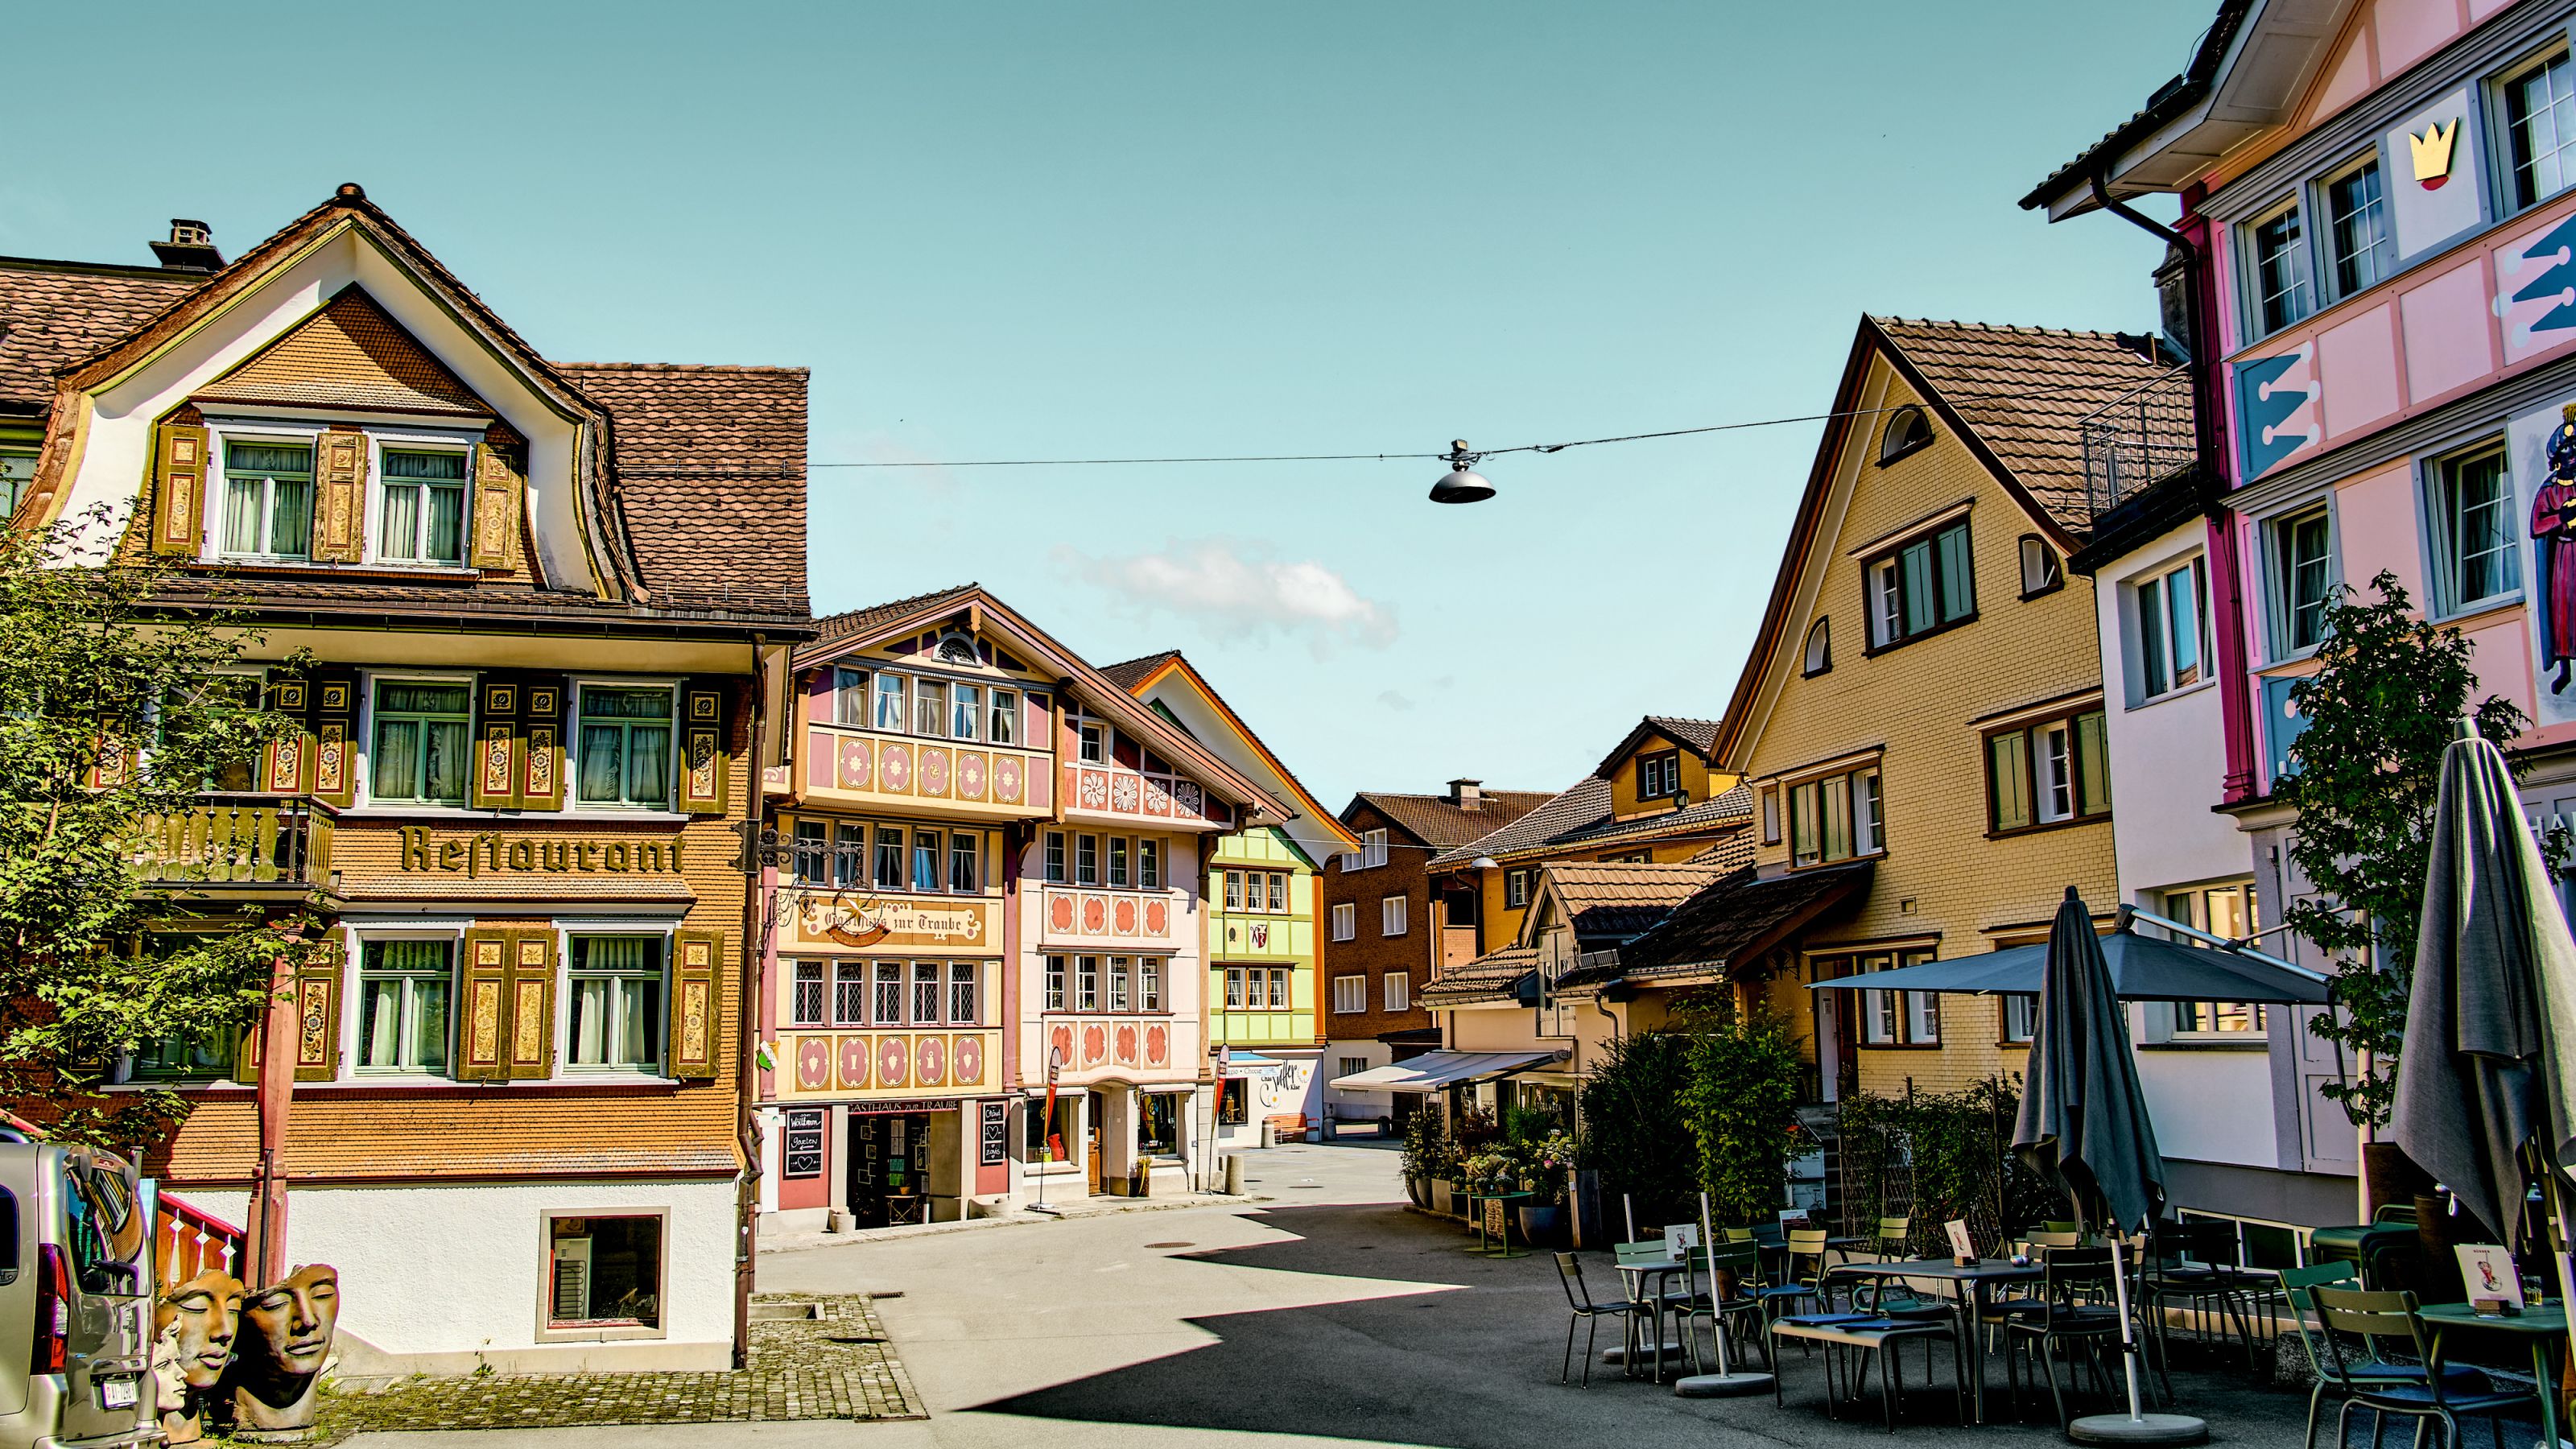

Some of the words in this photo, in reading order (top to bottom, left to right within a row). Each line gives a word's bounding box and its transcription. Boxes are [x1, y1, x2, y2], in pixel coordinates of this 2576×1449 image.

[2529, 811, 2576, 840] HA
[398, 825, 687, 879] Restaurant
[894, 919, 914, 929] zur
[919, 914, 961, 931] Traube
[904, 1104, 919, 1112] ZUR
[920, 1100, 958, 1111] TRAUBE
